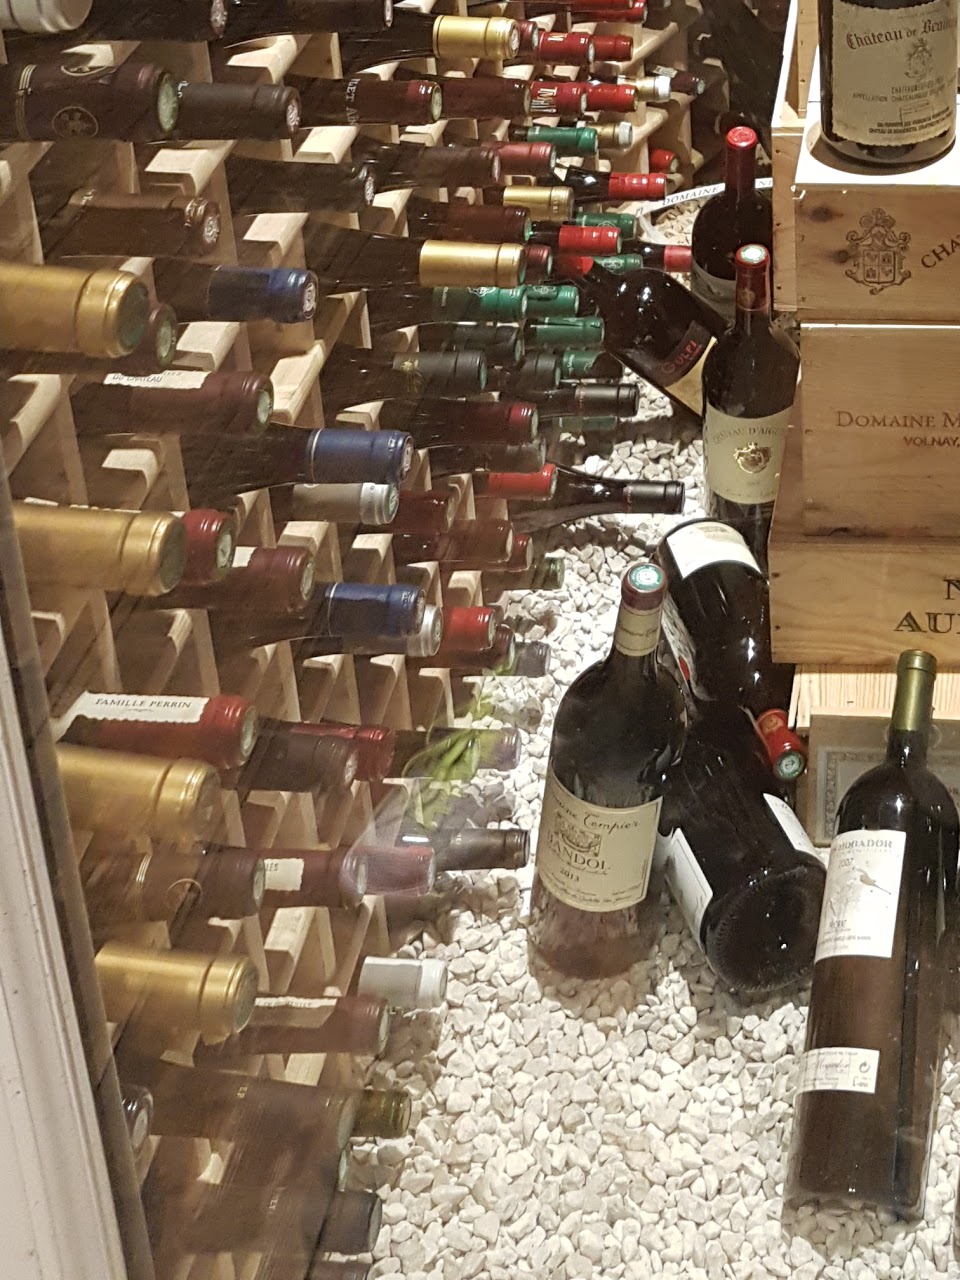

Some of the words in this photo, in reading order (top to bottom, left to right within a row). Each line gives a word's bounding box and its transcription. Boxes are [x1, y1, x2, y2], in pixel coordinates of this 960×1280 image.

[905, 26, 918, 39] de
[662, 185, 720, 206] DOMAINE
[903, 435, 960, 450] VOLNAY,
[95, 697, 146, 708] FAMILLE
[150, 700, 192, 709] PERRIN
[560, 868, 580, 883] 2013
